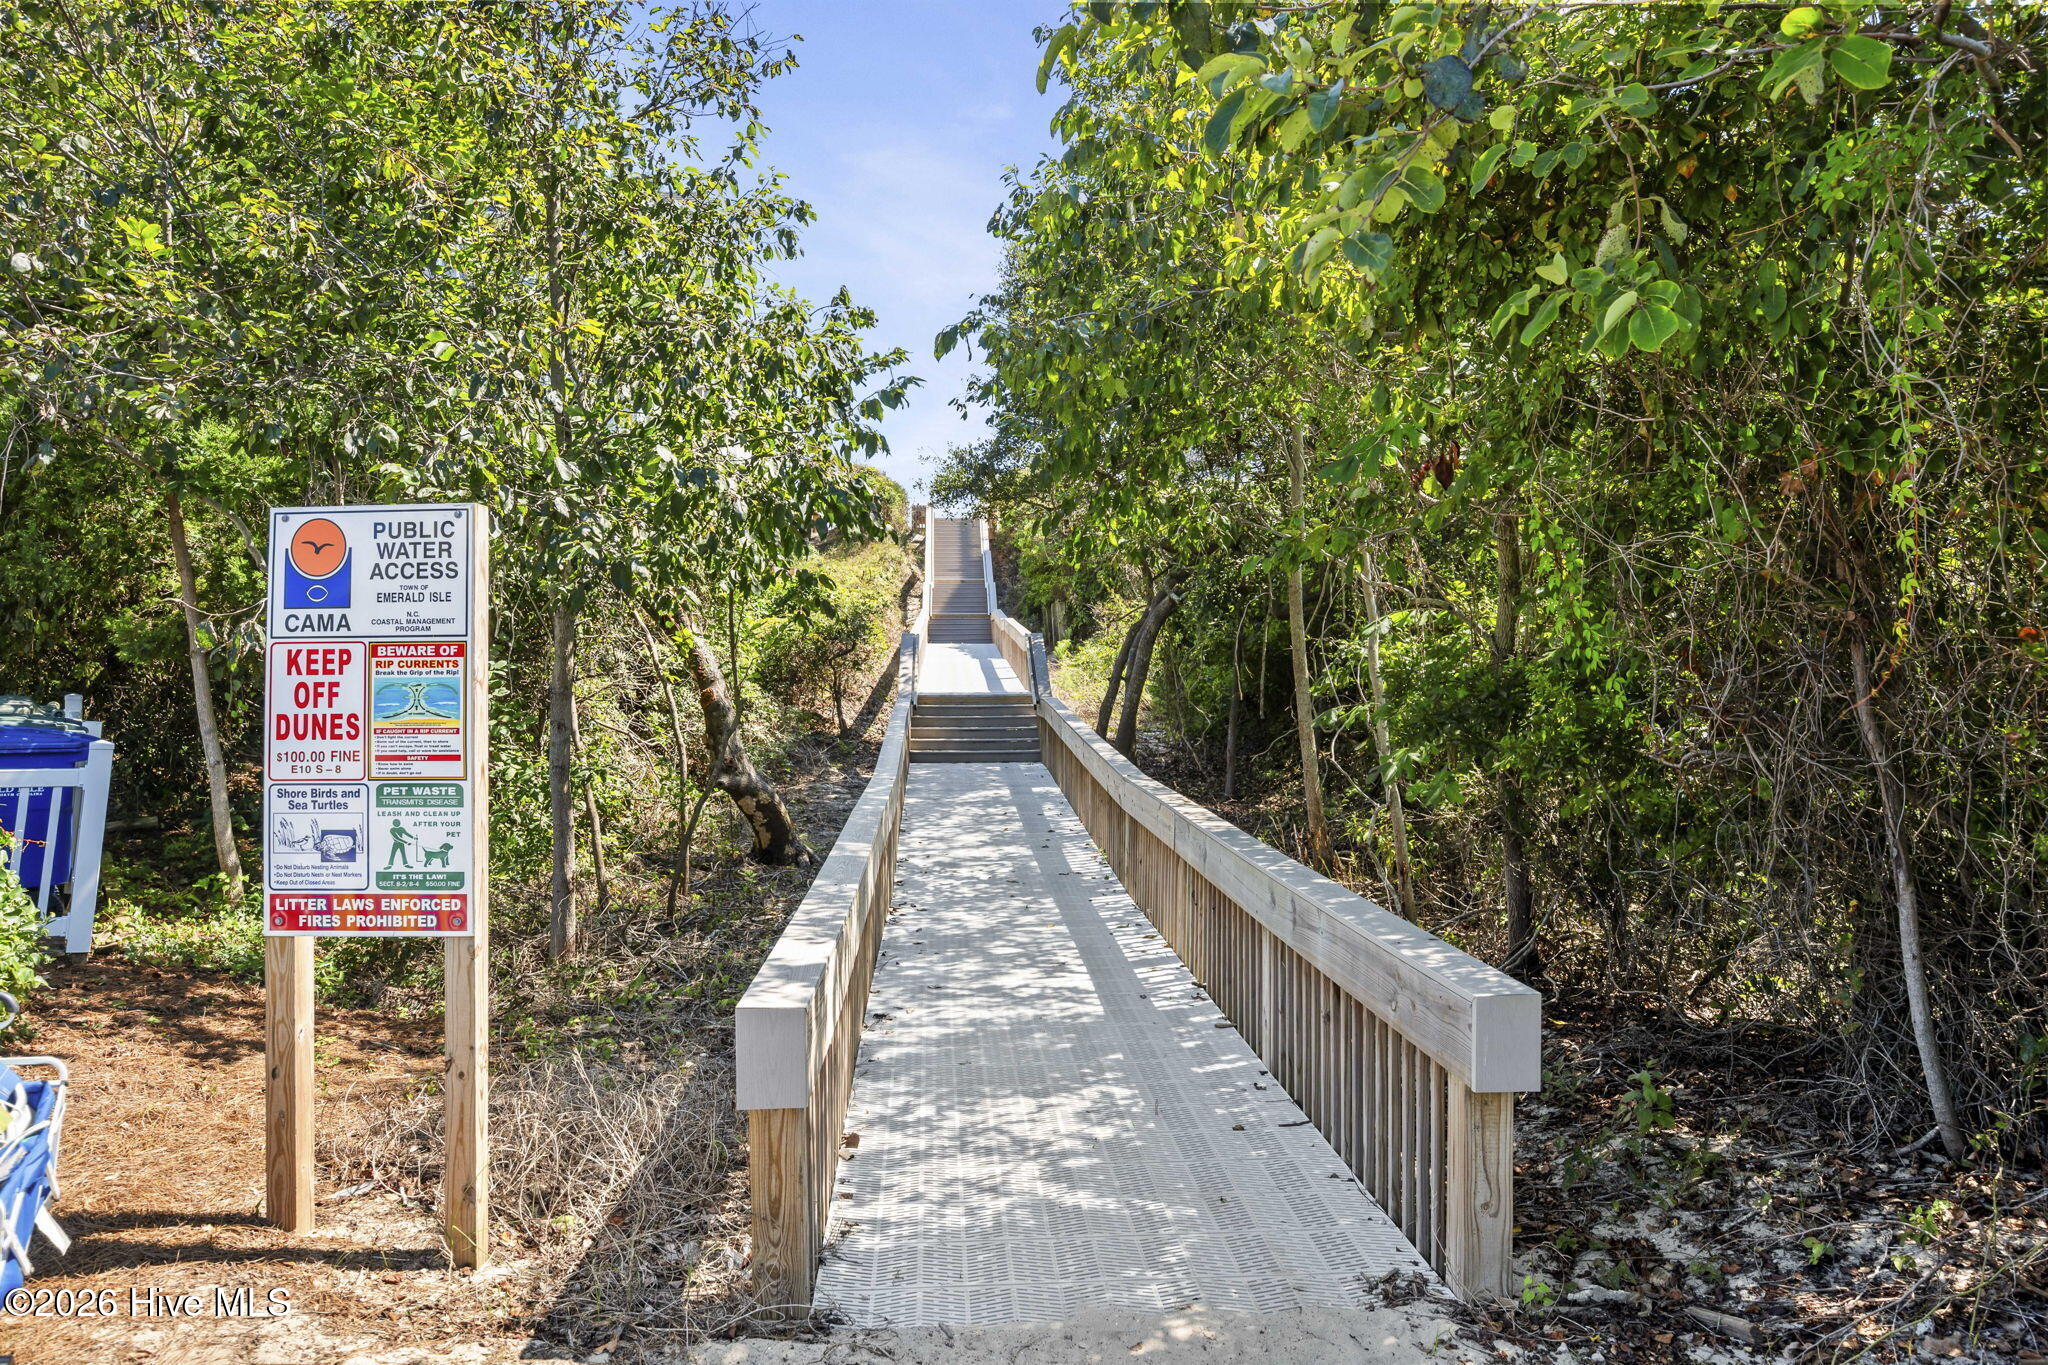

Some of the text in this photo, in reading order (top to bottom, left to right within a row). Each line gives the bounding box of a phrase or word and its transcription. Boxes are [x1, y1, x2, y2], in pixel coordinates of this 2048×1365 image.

[373, 520, 455, 539] PUBLIC
[376, 541, 452, 560] WATER
[370, 562, 459, 580] ACCESS
[376, 592, 452, 603] EMERALD ISLE
[285, 614, 351, 632] CAMA
[377, 646, 458, 656] BEWARE OF
[286, 649, 352, 676] KEEP
[375, 660, 459, 668] RIP CURRENTS
[294, 682, 340, 709] OFF
[276, 713, 360, 740] DUNES
[277, 751, 360, 762] $100.00 FINE
[291, 766, 311, 774] E10
[335, 765, 341, 773] 8
[277, 789, 360, 798] Shore Birds and
[384, 787, 456, 795] PET WASTE
[288, 800, 348, 810] Sea Turtles
[276, 899, 461, 910] LITTER LAWS ENFORCED
[299, 915, 437, 927] FIRES PROHIBITED
